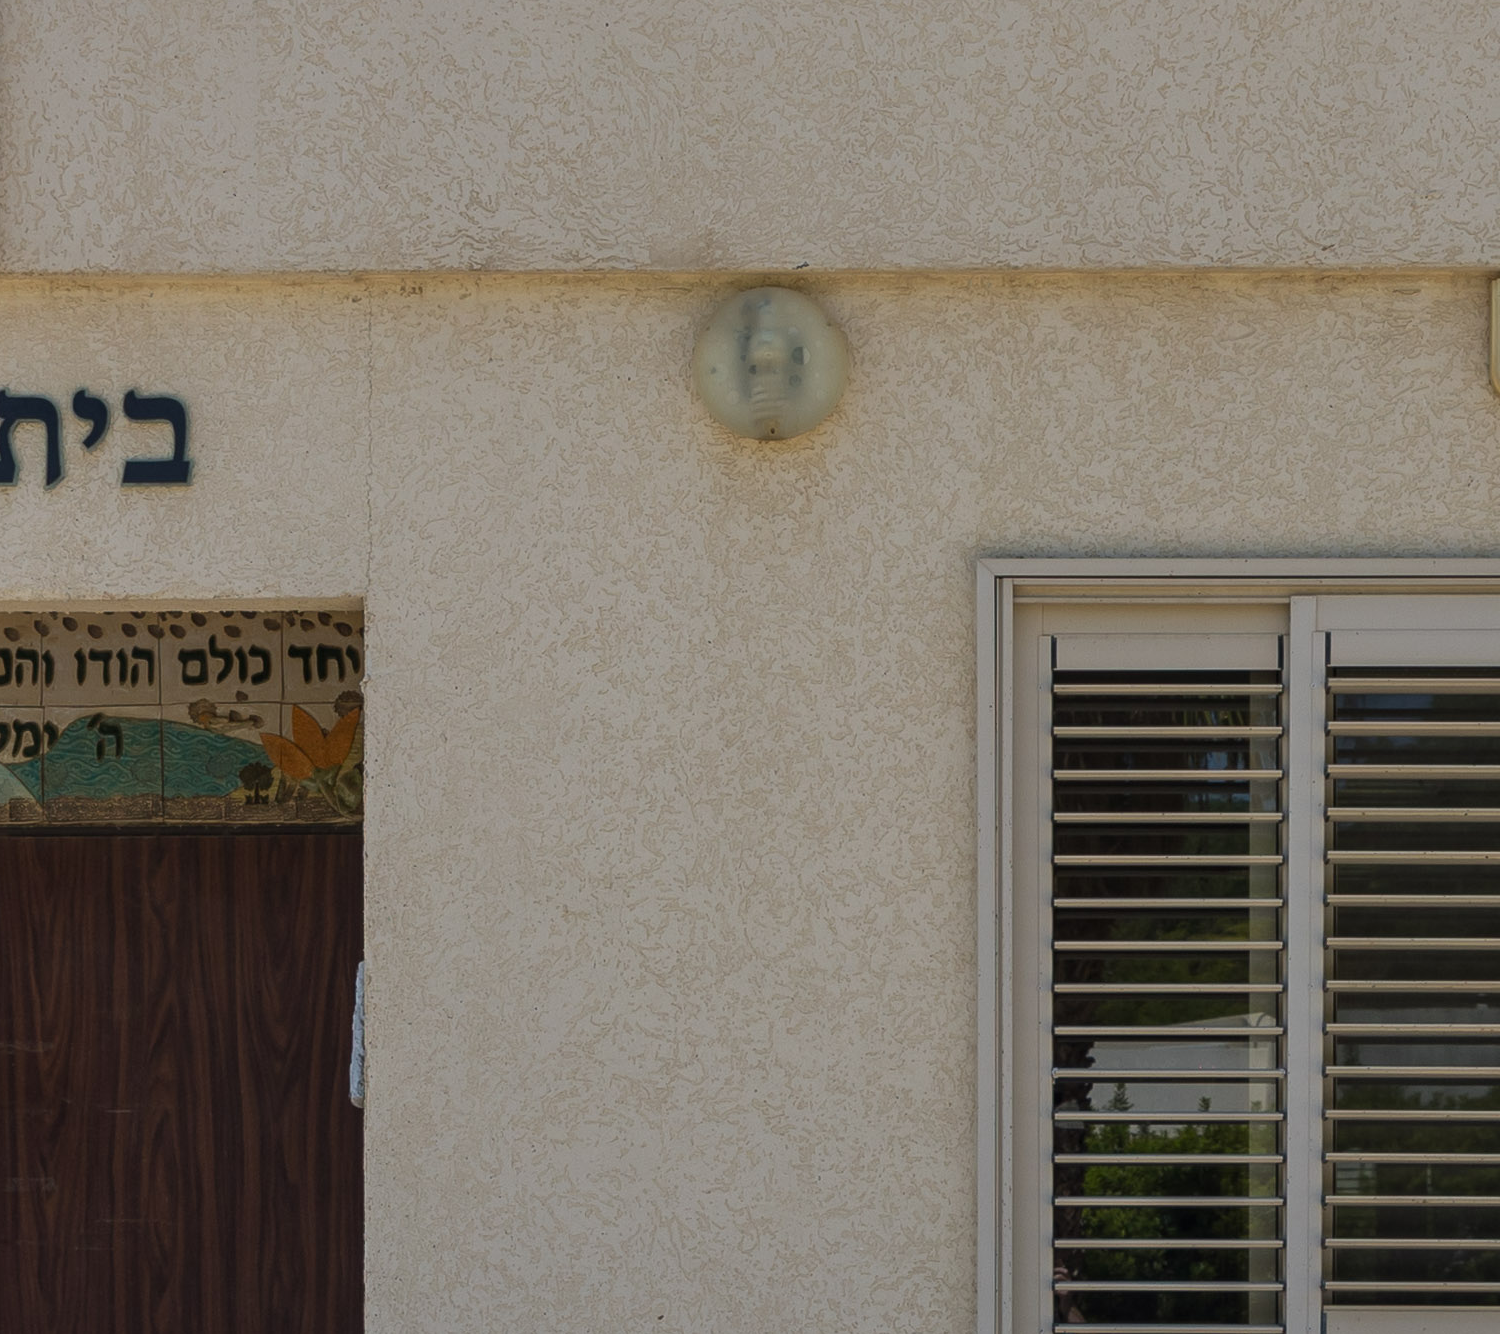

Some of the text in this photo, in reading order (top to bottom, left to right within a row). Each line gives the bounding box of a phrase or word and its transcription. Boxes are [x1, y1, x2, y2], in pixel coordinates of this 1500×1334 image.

[73, 643, 156, 688] הודו
[177, 634, 272, 686] כולם
[288, 642, 361, 684] יחד
